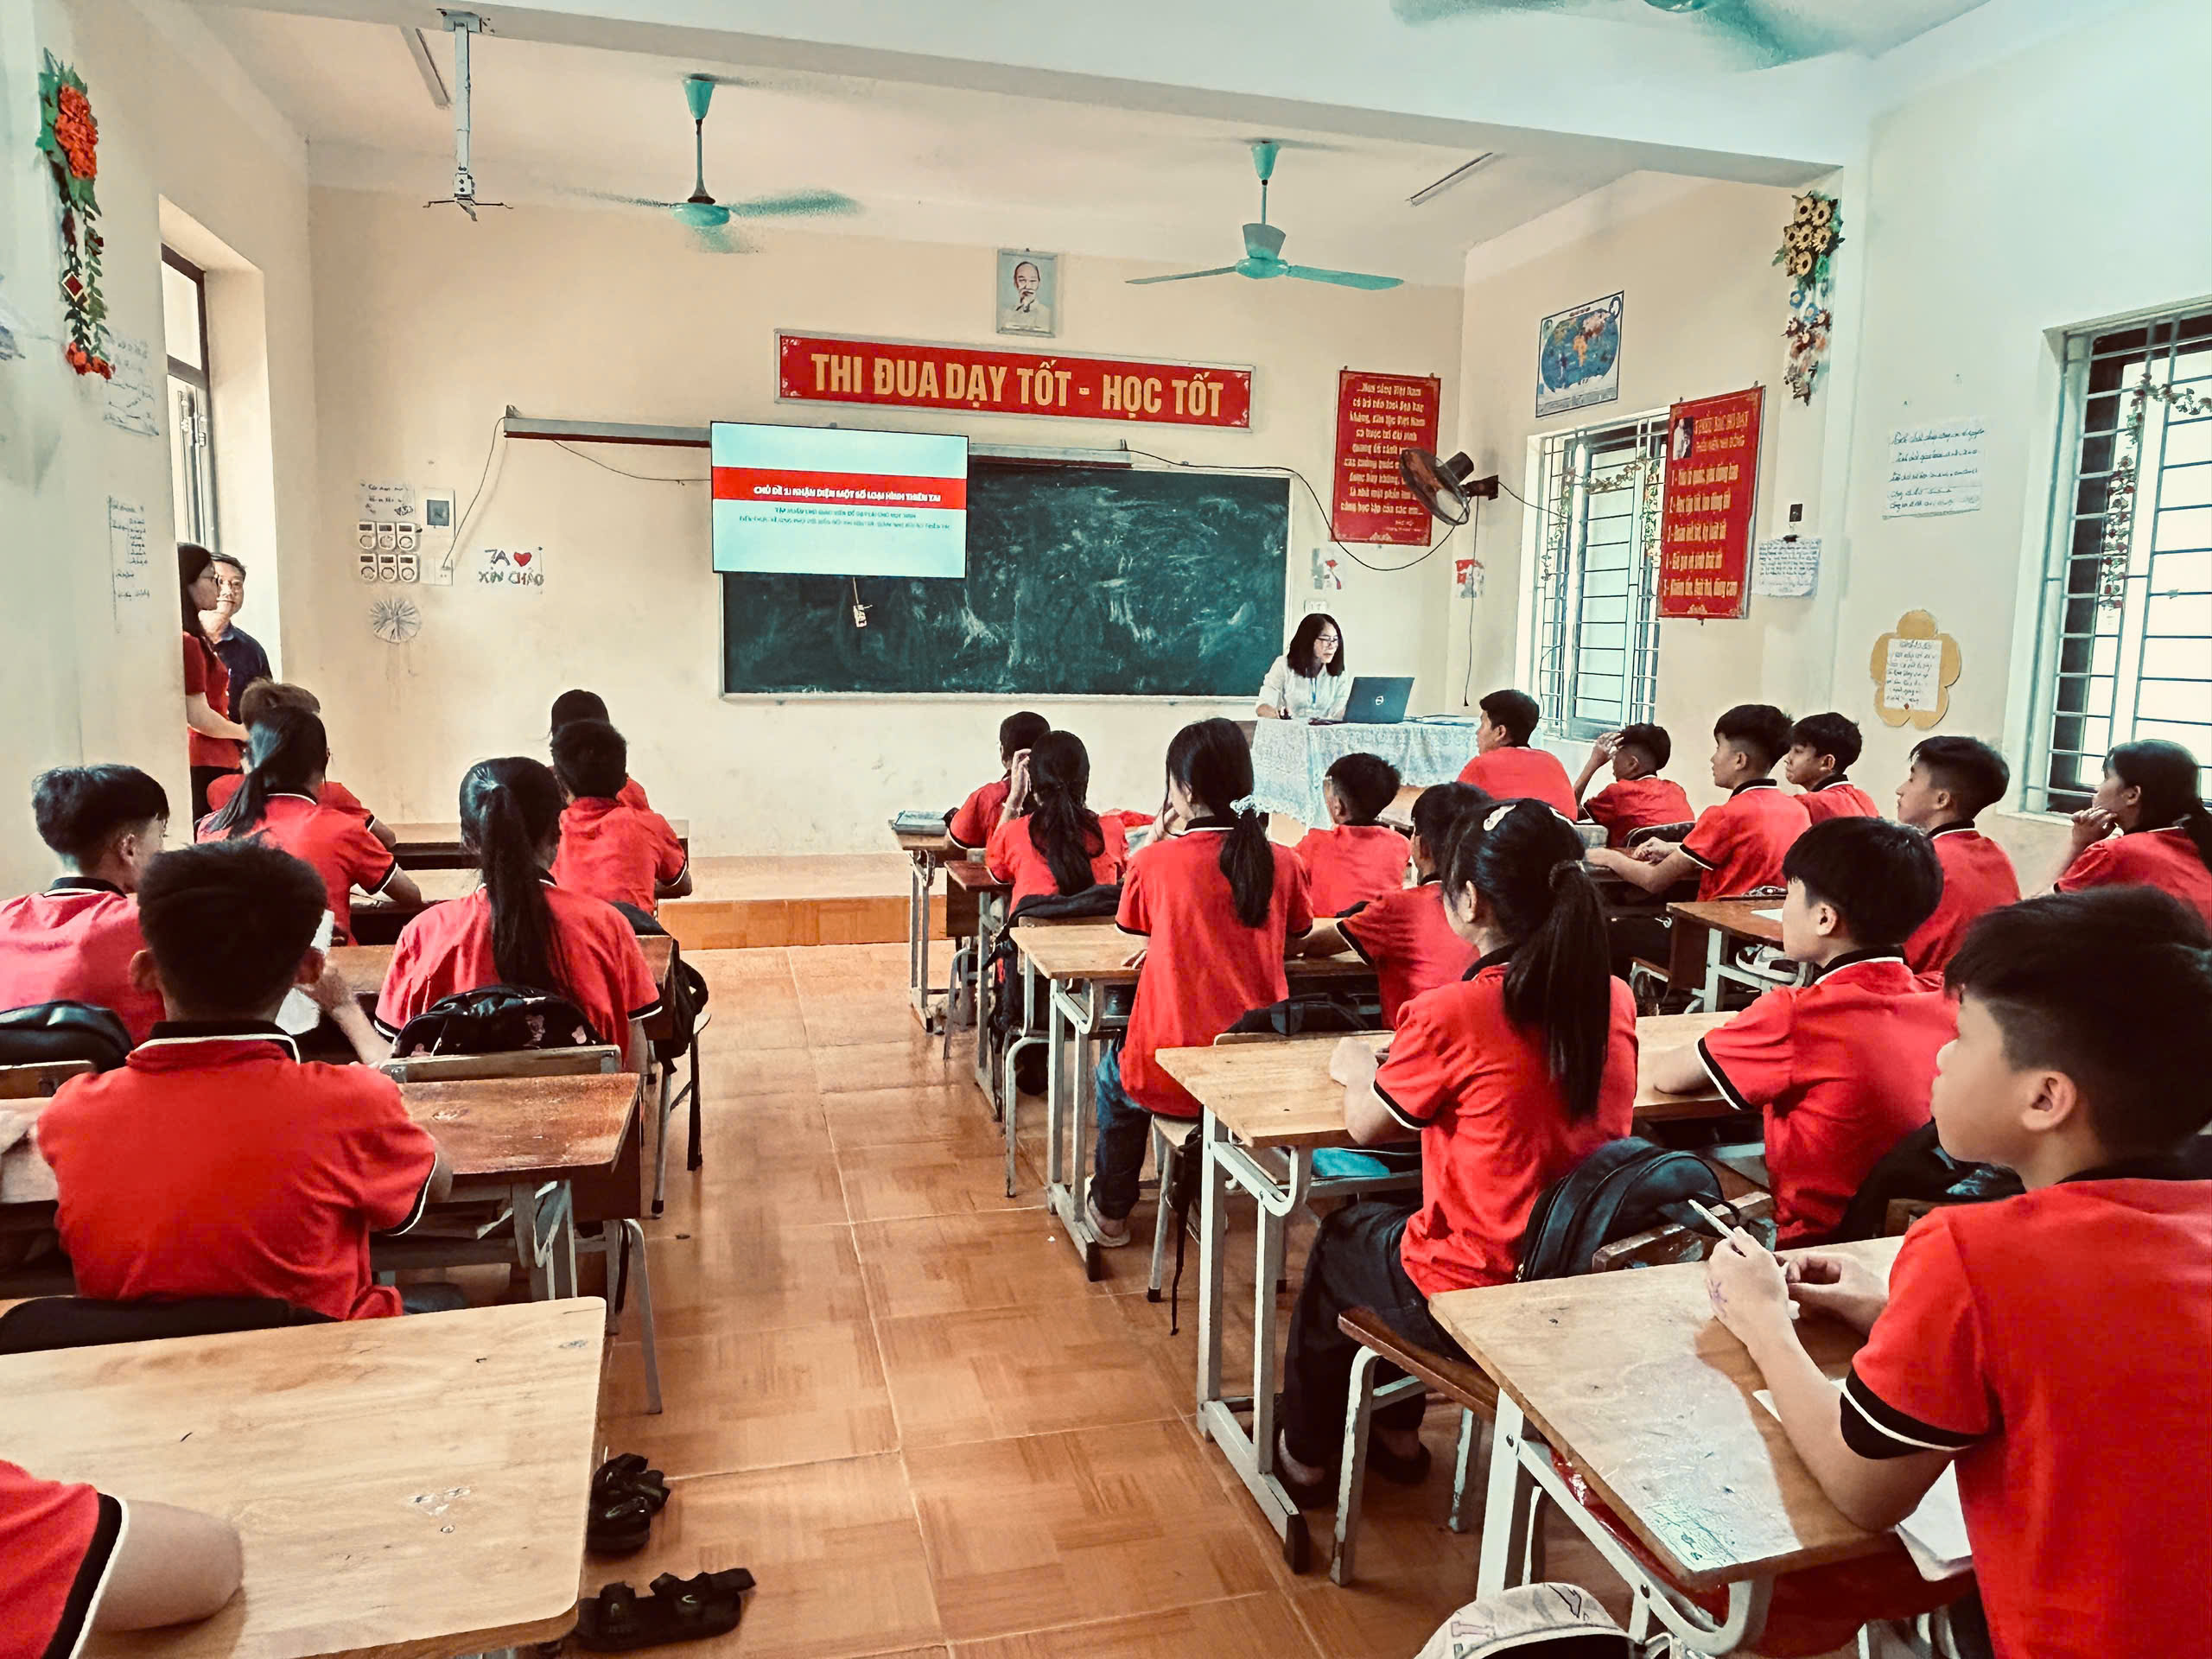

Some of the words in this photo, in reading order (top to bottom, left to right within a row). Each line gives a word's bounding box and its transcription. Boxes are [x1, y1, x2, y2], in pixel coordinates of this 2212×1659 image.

[811, 353, 862, 395] THI
[873, 357, 940, 399] ĐUA
[944, 363, 1007, 407] DẠY
[1017, 359, 1071, 407] TỐT
[1102, 374, 1162, 418] HỌC
[1171, 372, 1224, 418] TỐT
[485, 549, 511, 566] 7A
